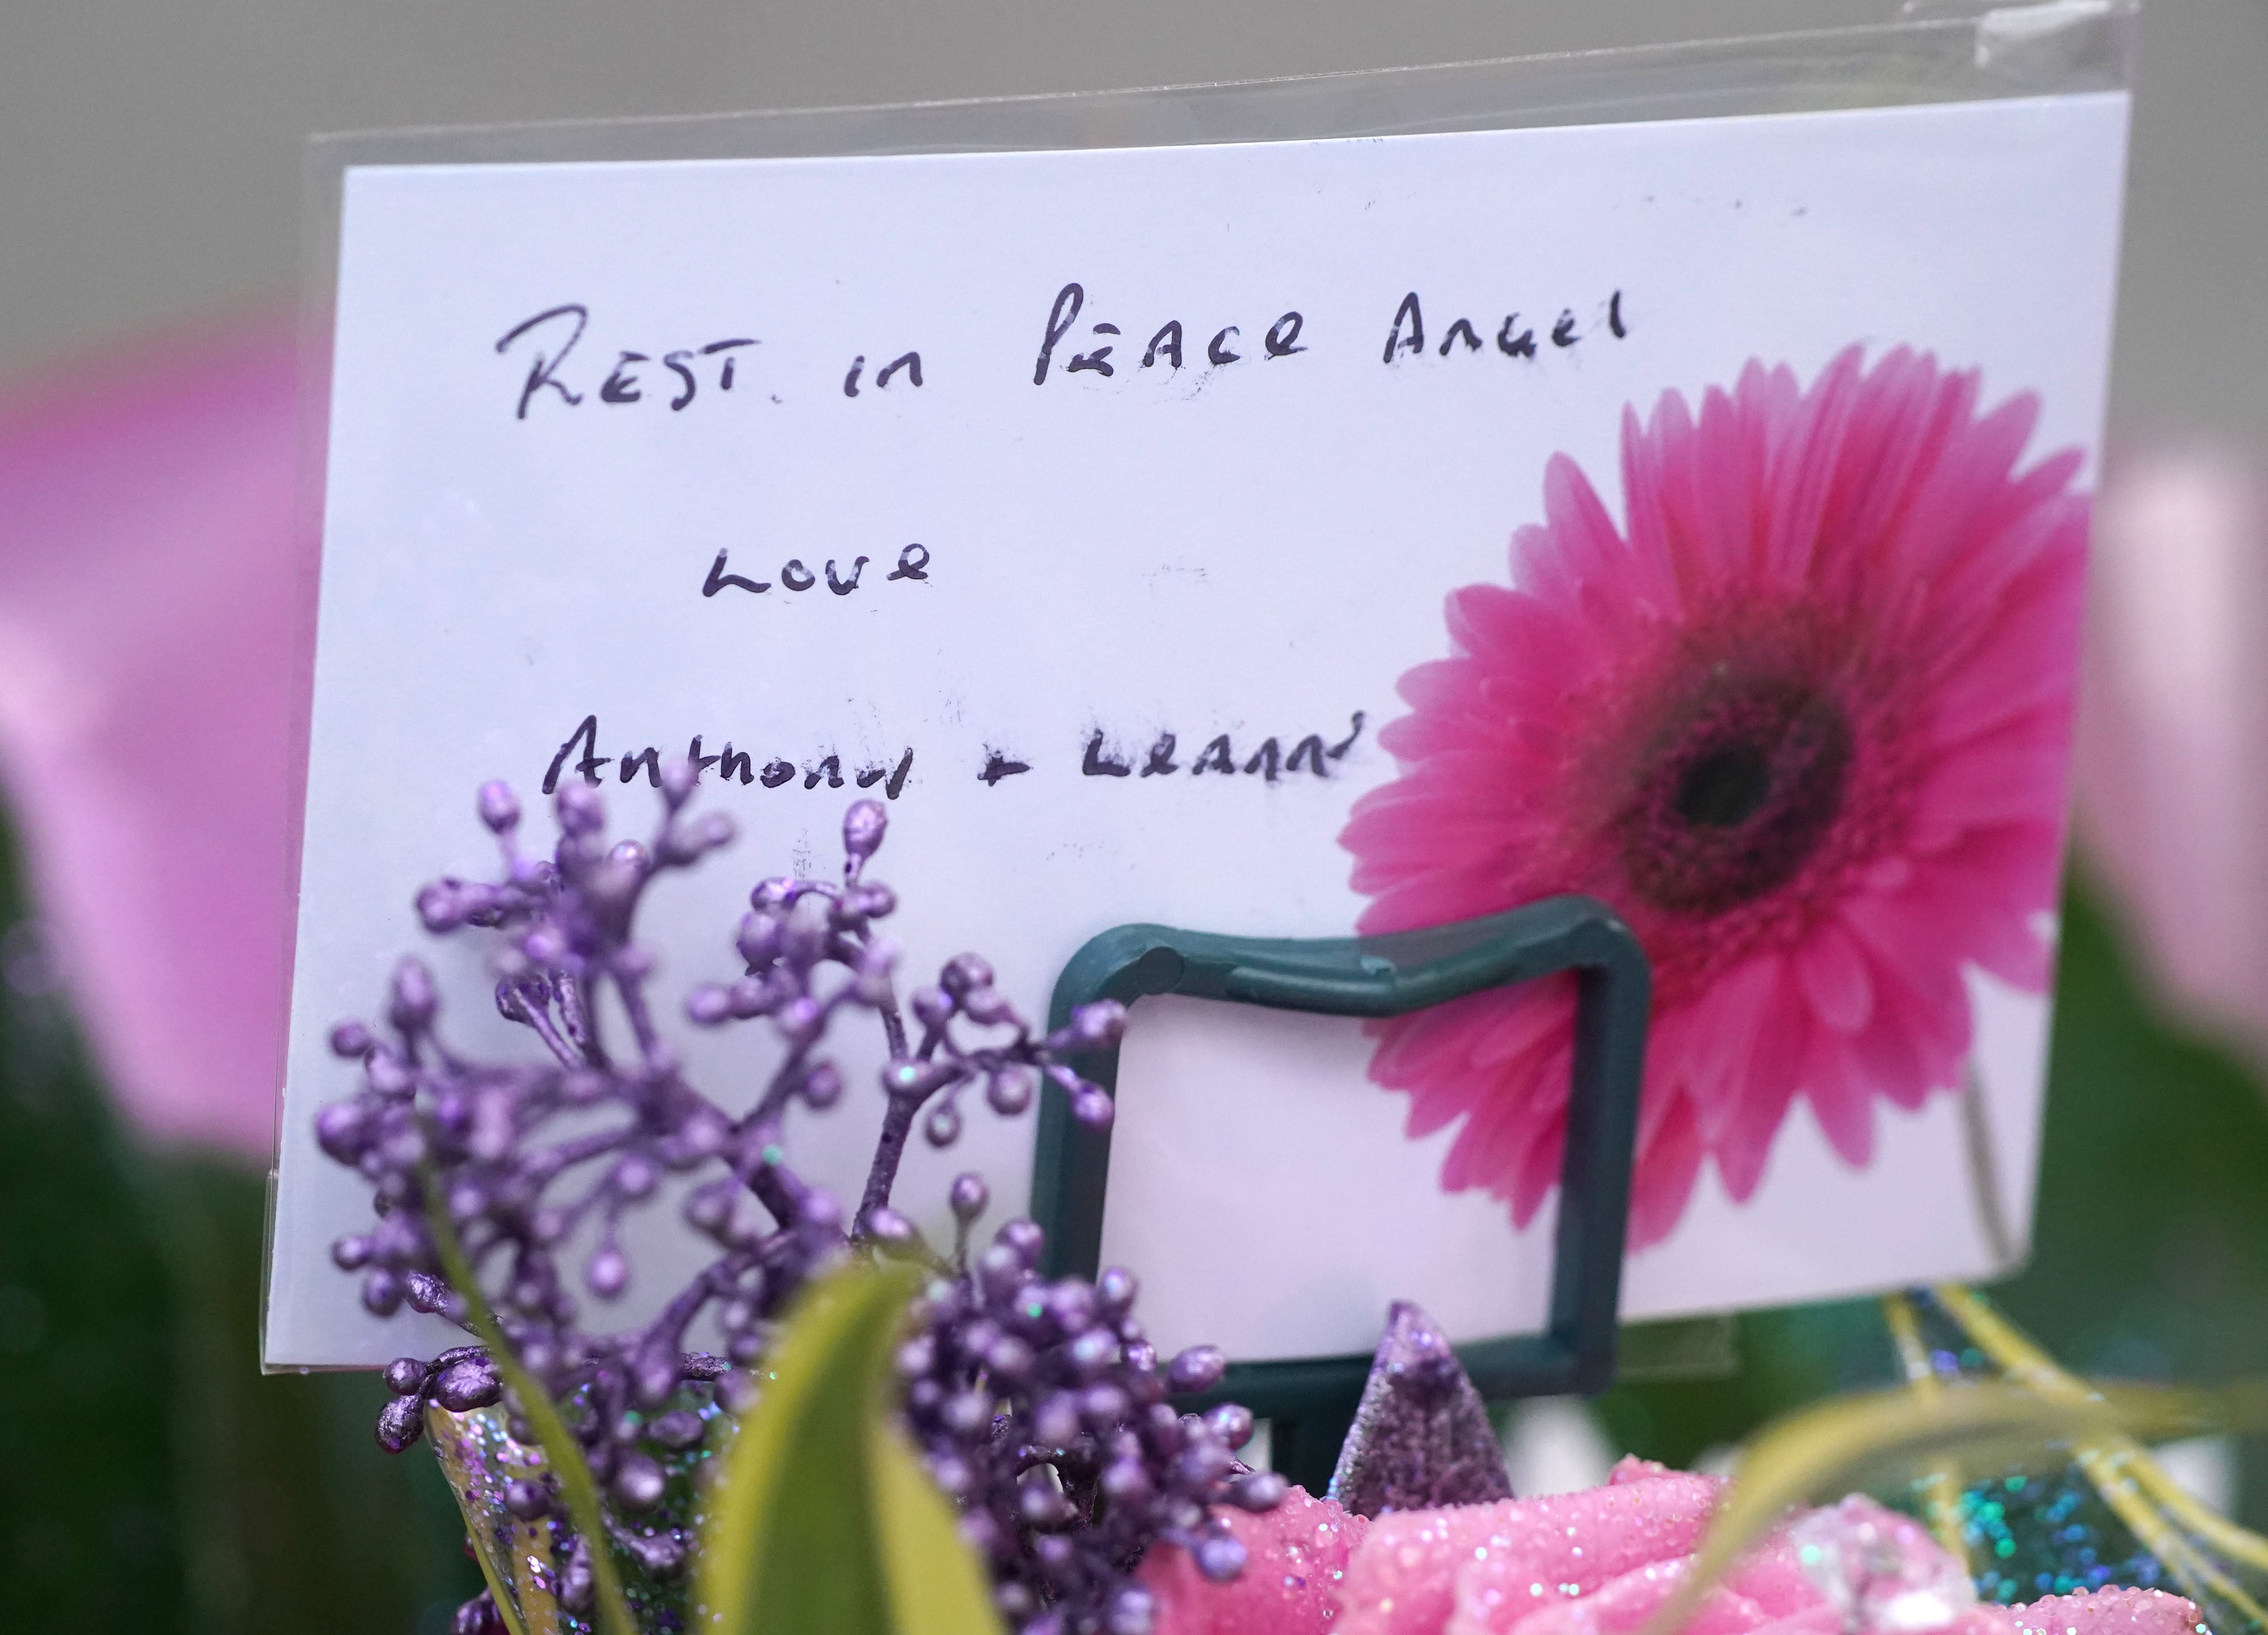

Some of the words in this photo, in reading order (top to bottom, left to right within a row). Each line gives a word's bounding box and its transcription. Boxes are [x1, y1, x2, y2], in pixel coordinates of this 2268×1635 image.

[844, 351, 923, 397] in
[703, 543, 930, 598] Love
[541, 714, 915, 800] Anthony
